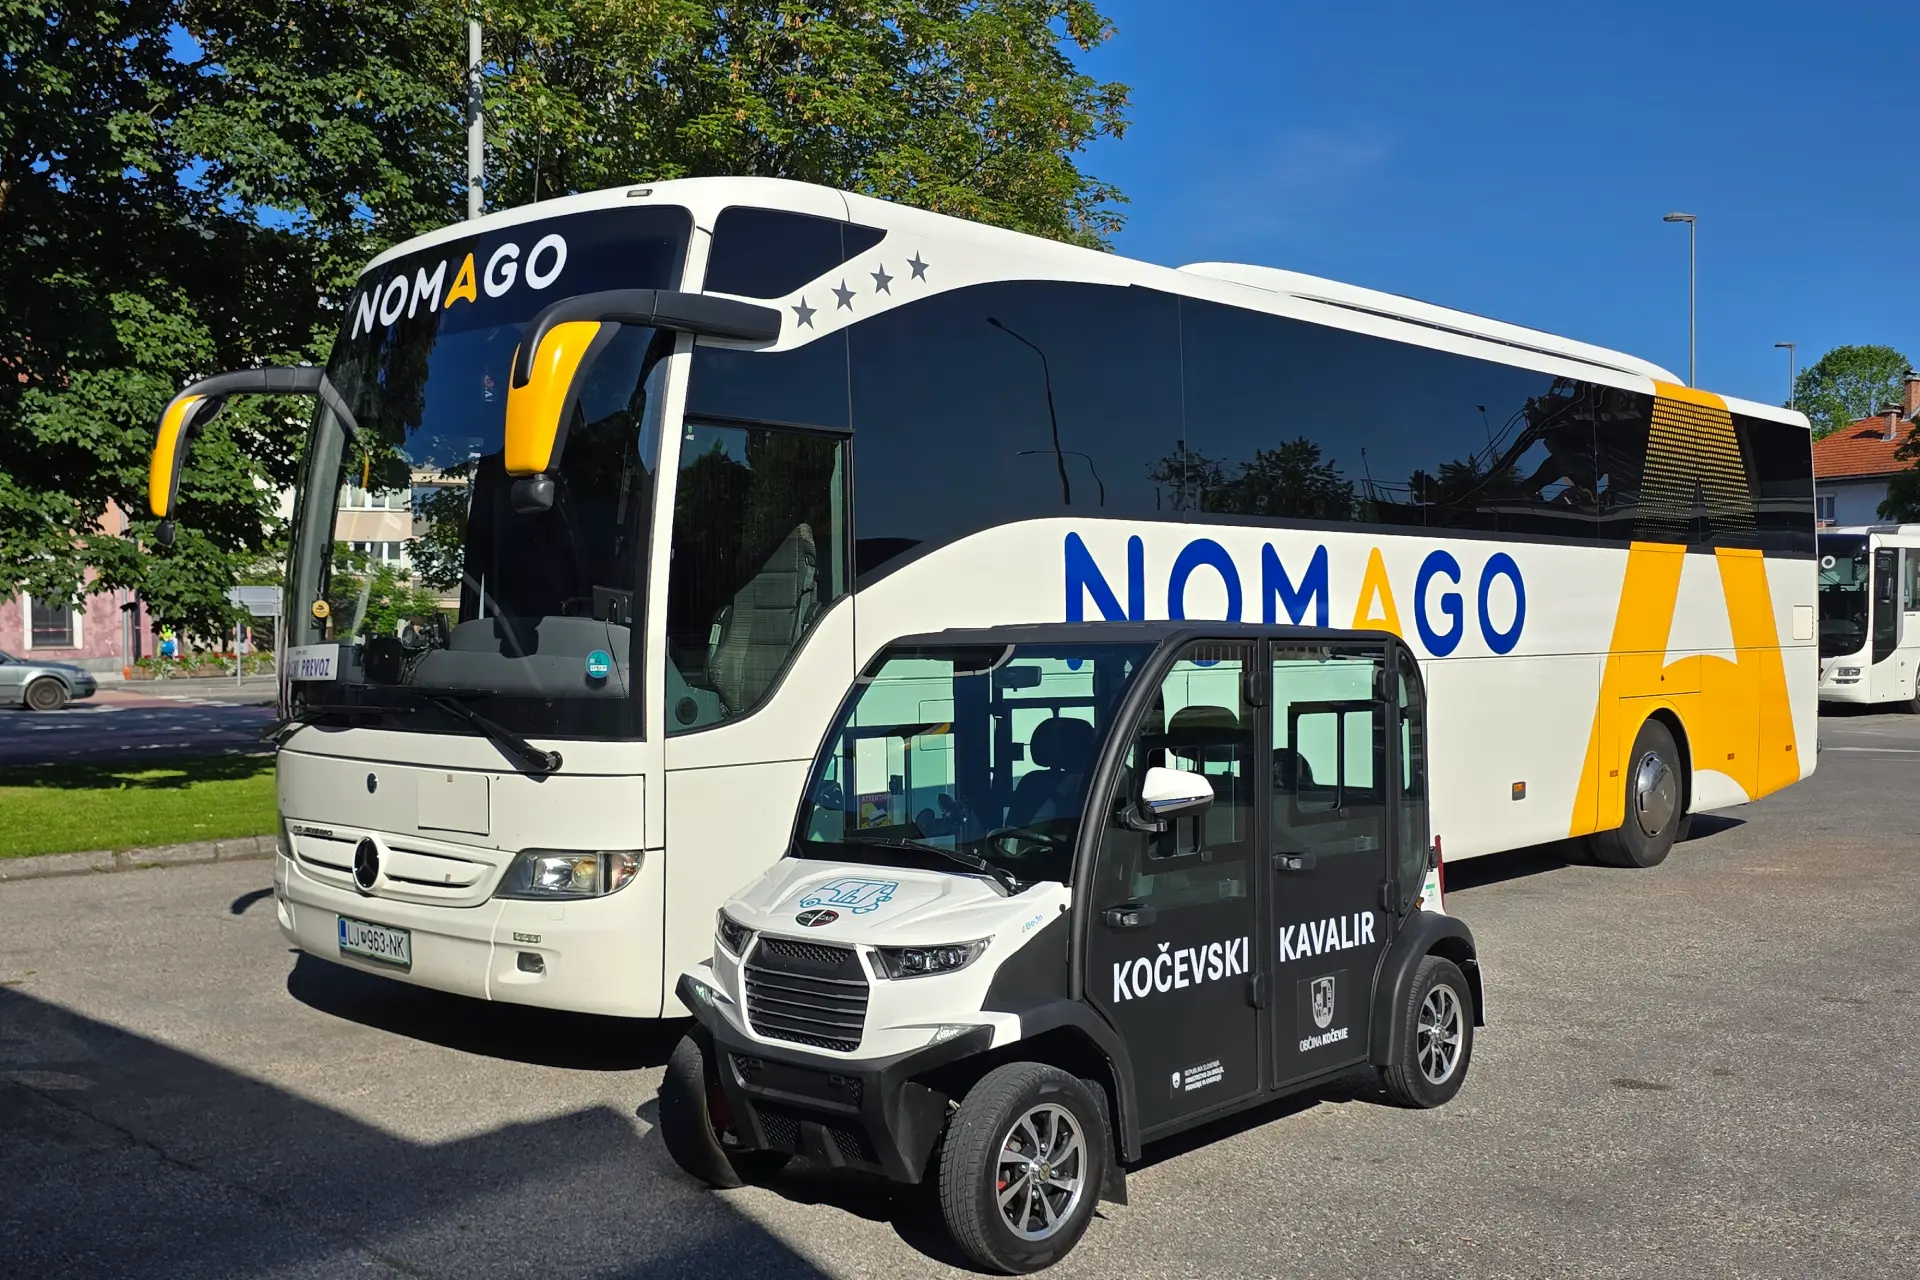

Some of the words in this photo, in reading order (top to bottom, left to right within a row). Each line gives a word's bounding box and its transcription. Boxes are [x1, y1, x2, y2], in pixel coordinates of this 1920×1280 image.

[351, 233, 568, 340] NOMAGO
[1064, 531, 1527, 658] NOMAGO
[301, 658, 331, 677] PREVOZ
[347, 923, 360, 947] LJ
[367, 929, 405, 958] 963-NK
[1113, 936, 1249, 1003] KOČEVSKI
[1279, 911, 1376, 963] KAVALIR
[1322, 1028, 1349, 1045] KOČEVJE
